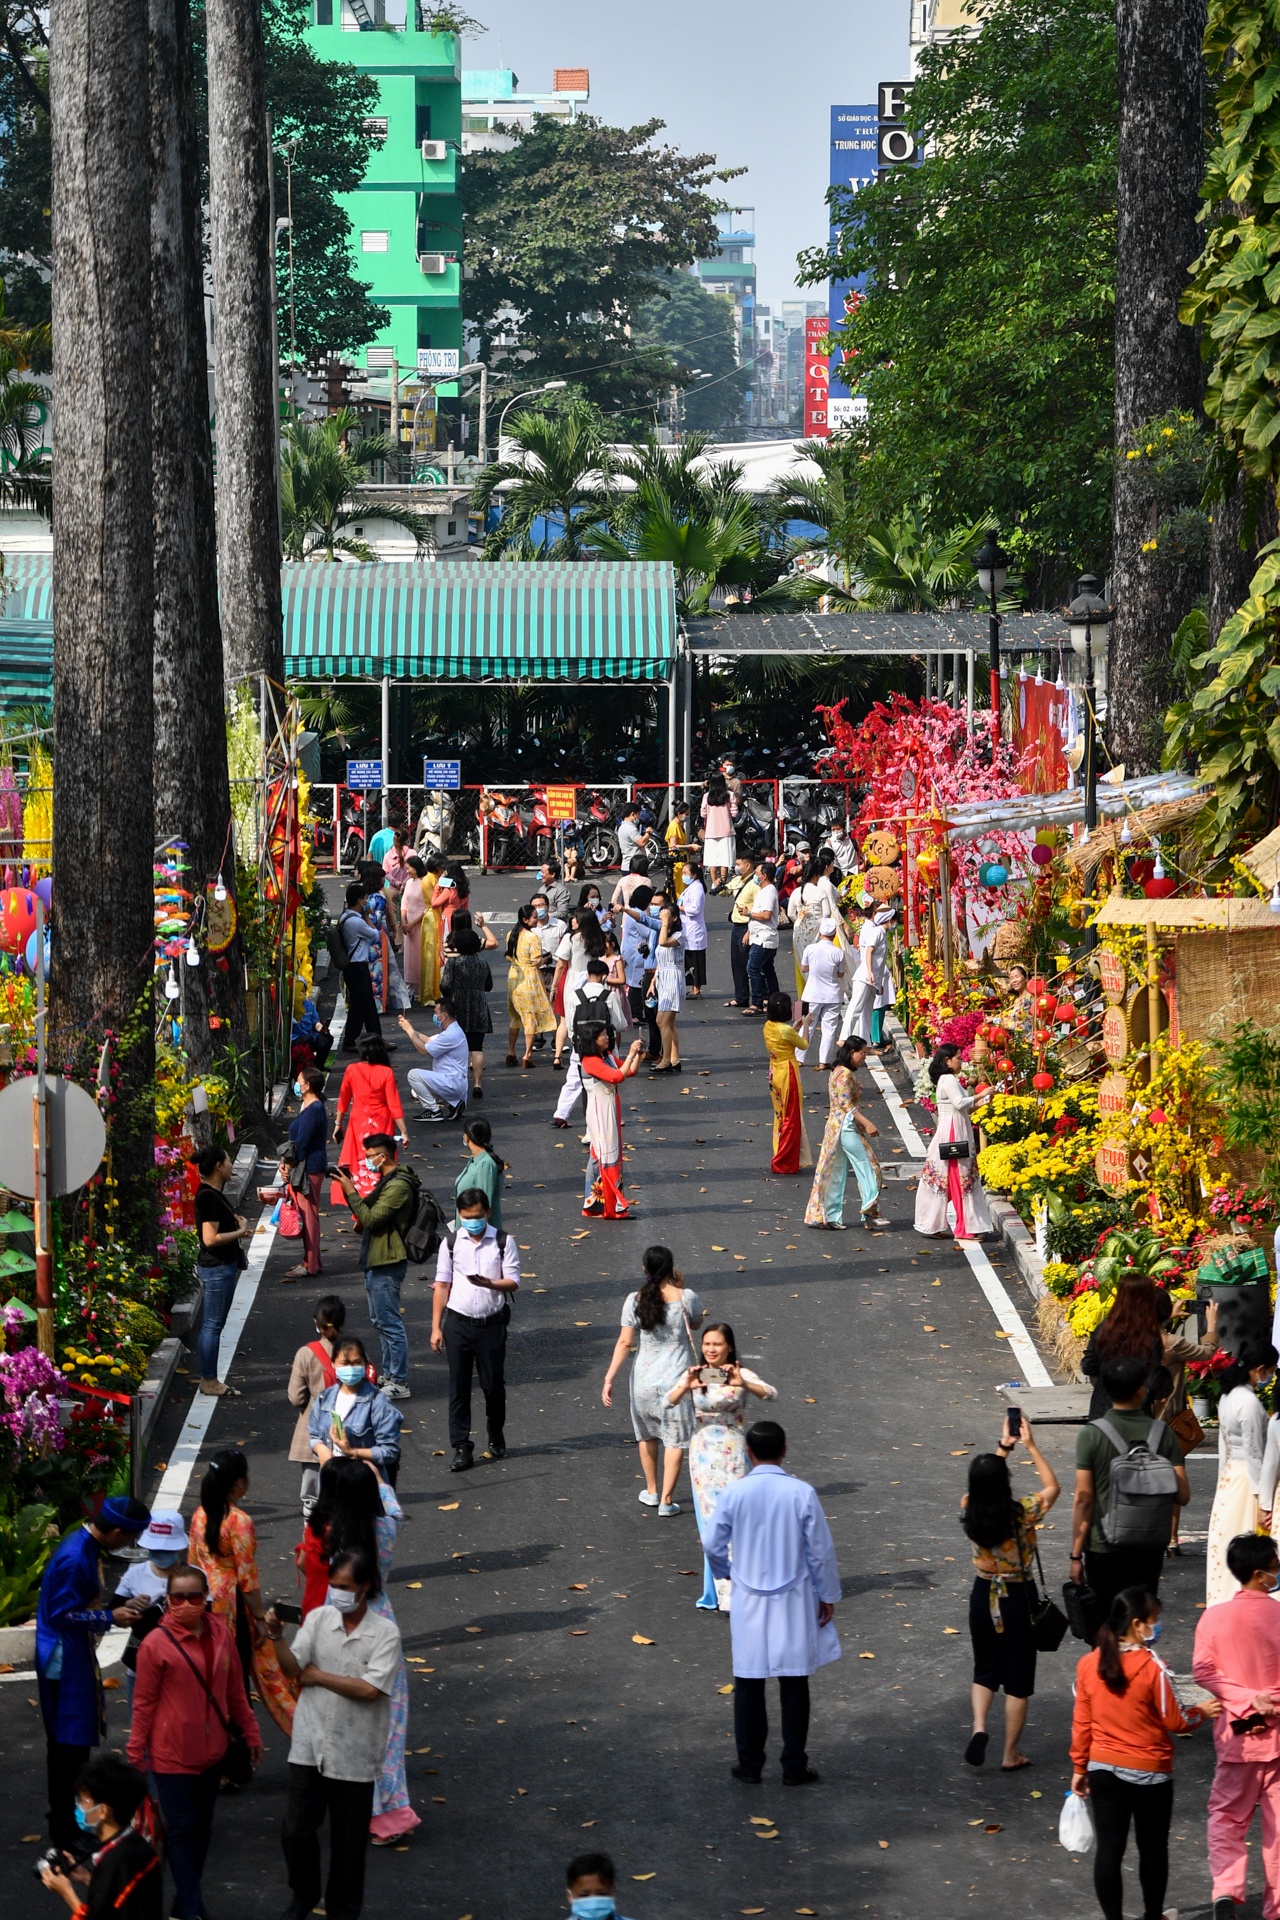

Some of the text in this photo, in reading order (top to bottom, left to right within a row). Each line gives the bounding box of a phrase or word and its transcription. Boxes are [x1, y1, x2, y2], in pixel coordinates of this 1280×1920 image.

[846, 114, 860, 122] GIÁO
[854, 126, 879, 135] TRƯ
[834, 140, 877, 152] TRUNG HỌC
[419, 350, 441, 368] PHÒNG
